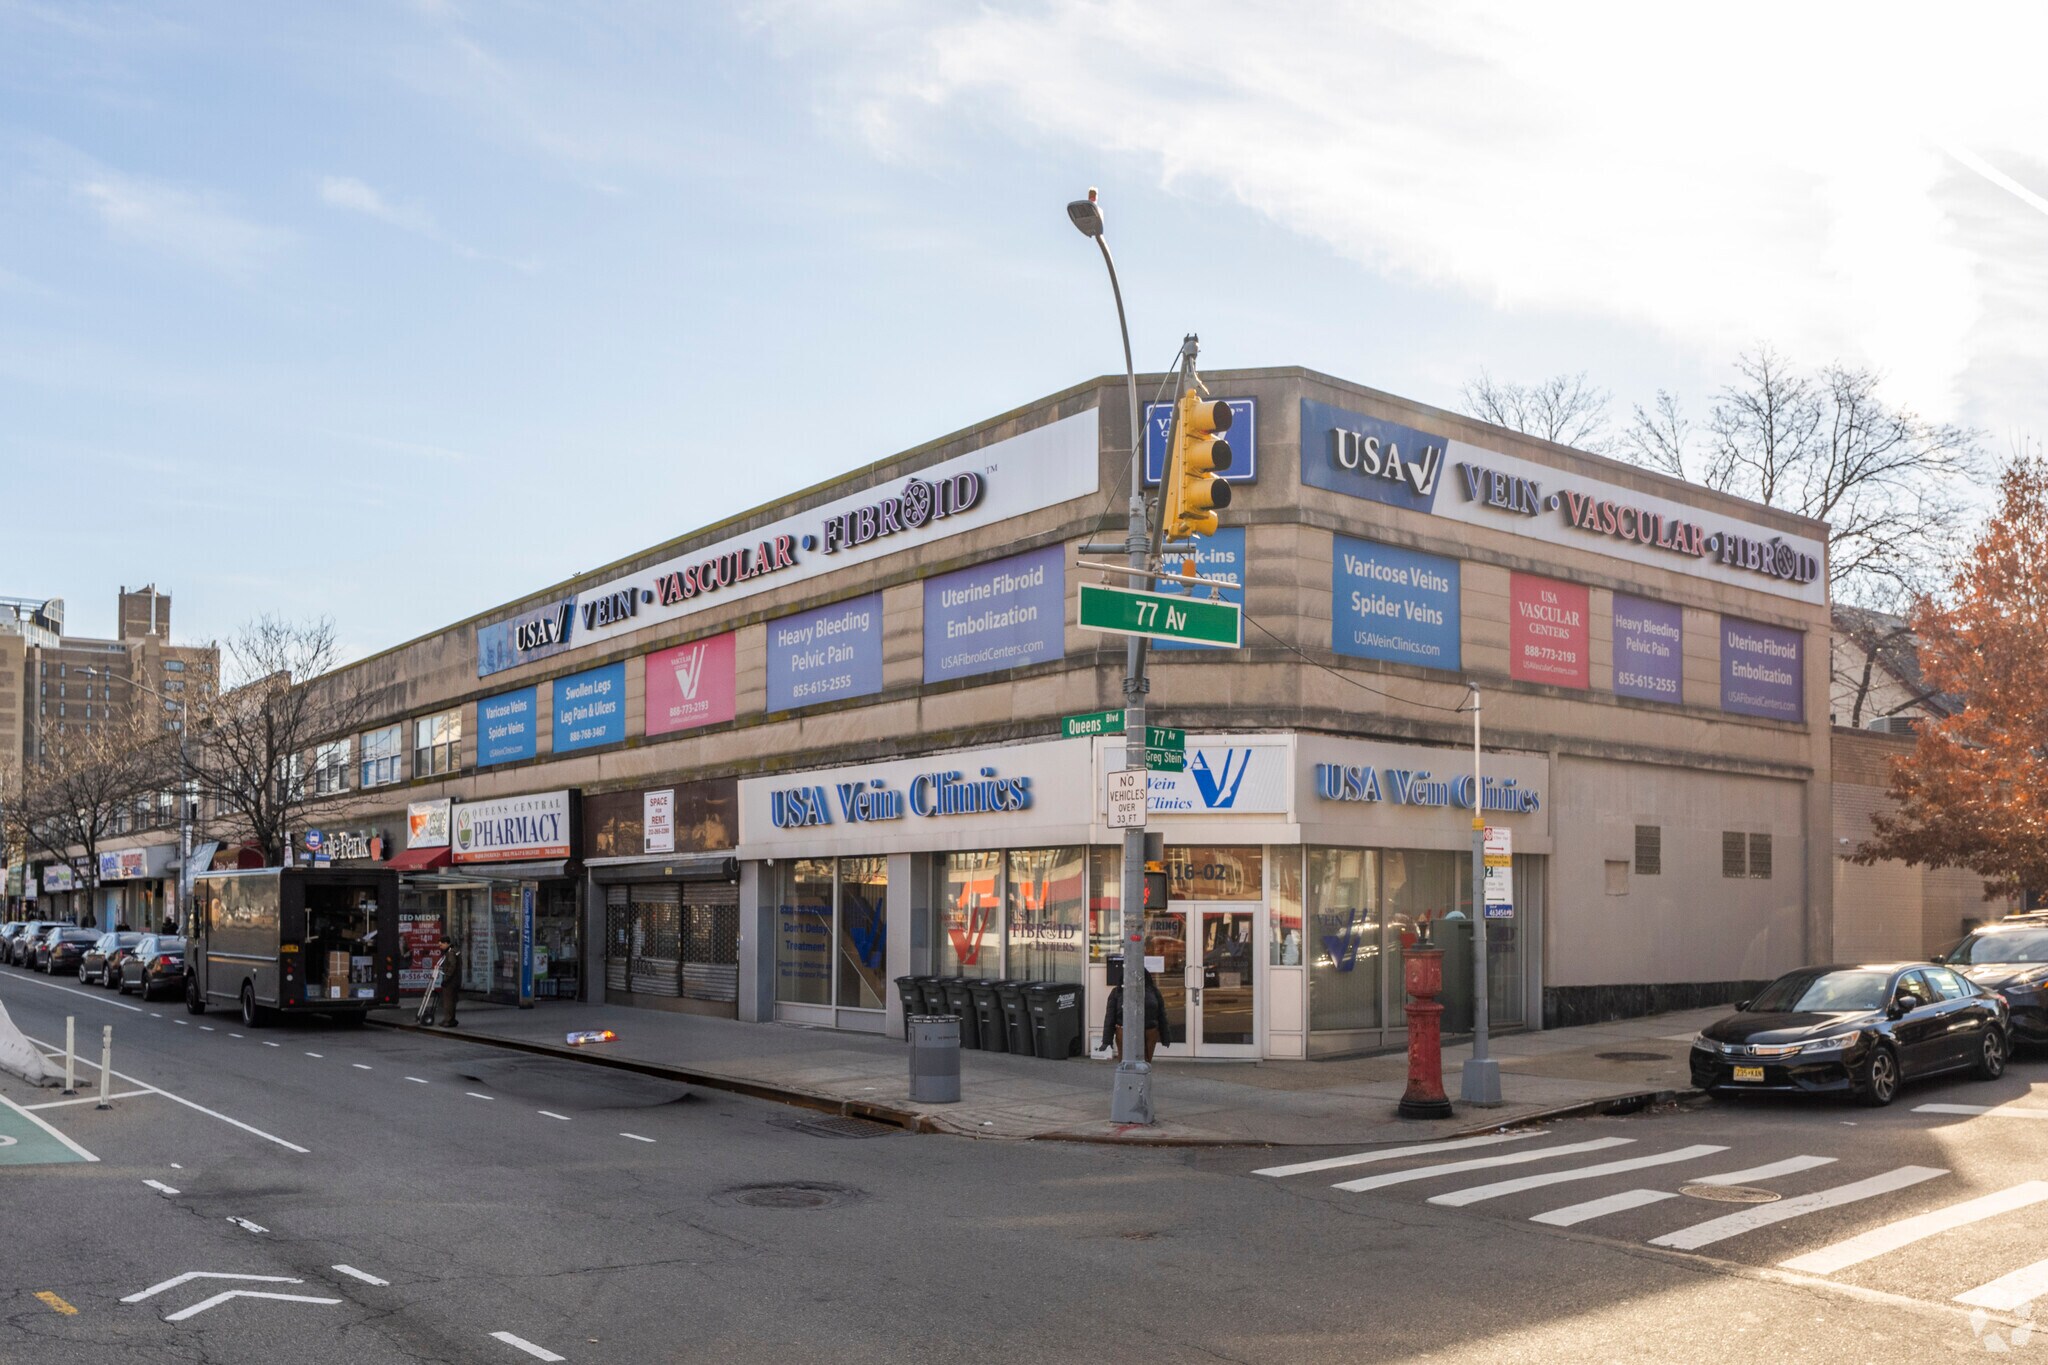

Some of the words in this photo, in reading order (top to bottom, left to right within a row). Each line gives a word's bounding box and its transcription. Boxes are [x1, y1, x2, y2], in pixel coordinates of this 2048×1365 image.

[1335, 427, 1407, 481] USA
[1459, 461, 1543, 517] VEIN
[1563, 490, 1706, 556] VASCULAR
[1721, 532, 1820, 584] FIBROID
[515, 620, 549, 651] USA
[580, 588, 634, 630] VEIN
[654, 534, 794, 606] VASCULAR
[821, 470, 981, 555] FIBROID
[1344, 553, 1408, 585] Varicose
[1410, 567, 1449, 593] Veins
[942, 582, 991, 608] Uterine
[992, 565, 1044, 596] Fibroid
[1541, 590, 1558, 604] USA
[1136, 600, 1159, 627] 77
[1165, 605, 1187, 631] Av
[1351, 591, 1401, 618] Spider
[1404, 600, 1443, 625] Veins
[1519, 601, 1580, 627] VASCULAR
[778, 626, 813, 648] Heavy
[815, 611, 870, 638] Bleeding
[947, 605, 1038, 639] Embolization
[1529, 622, 1570, 639] CENTERS
[1615, 614, 1642, 634] Heavy
[1643, 619, 1680, 642] Bleeding
[1354, 630, 1440, 656] USAVeinClinics.com
[1524, 644, 1577, 663] 888-773-2193
[1626, 637, 1651, 654] Pelvic
[1652, 641, 1670, 658] Pain
[1728, 631, 1763, 653] Uterine
[1763, 639, 1796, 660] Fibroid
[792, 650, 825, 672] Pelvic
[827, 644, 854, 662] Pain
[941, 640, 1044, 670] USAFibroidCenters.com
[1618, 672, 1677, 693] 855-615-2555
[1732, 660, 1793, 685] Embolization
[566, 683, 593, 700] Swollen
[594, 680, 611, 695] Legs
[793, 675, 852, 698] 855-615-2555
[486, 703, 510, 720] Varicose
[510, 700, 527, 714] Veins
[561, 710, 573, 726] Leg
[573, 706, 587, 720] Pain
[588, 705, 594, 716] &
[594, 700, 616, 716] Ulcers
[488, 726, 506, 741] Spider
[507, 722, 525, 737] Veins
[1069, 719, 1101, 735] Queens
[1106, 713, 1119, 722] Blvd
[1153, 730, 1165, 746] 77
[1168, 731, 1176, 740] Av
[1146, 751, 1162, 765] Greg
[1164, 752, 1182, 764] Stein
[1120, 775, 1134, 787] NO
[1146, 777, 1176, 790] Vein
[1319, 763, 1382, 801] USA
[1388, 769, 1448, 806] Vein
[1454, 775, 1540, 813] Clinics
[649, 796, 668, 807] SPACE
[771, 785, 830, 828] USA
[837, 779, 902, 823] Vein
[909, 768, 1028, 816] Clinics
[1110, 789, 1145, 802] VEHICLES
[1147, 797, 1193, 809] Clinics
[472, 806, 508, 819] QUEENS
[514, 798, 561, 812] CENTRAL
[1118, 803, 1136, 812] OVER
[652, 815, 666, 825] RENT
[1117, 815, 1126, 823] 33
[1128, 814, 1137, 822] FT
[474, 813, 561, 848] PHARMACY
[1163, 863, 1226, 881] 116-02
[523, 891, 531, 914] Queens
[415, 913, 441, 921] MEDS?
[523, 915, 531, 928] Blvd
[784, 922, 804, 933] Don't
[805, 924, 828, 937] Delay
[1012, 921, 1075, 940] FIBROID
[523, 944, 531, 966] Avenue
[786, 940, 825, 952] Treatment
[1029, 941, 1075, 953] CENTERS
